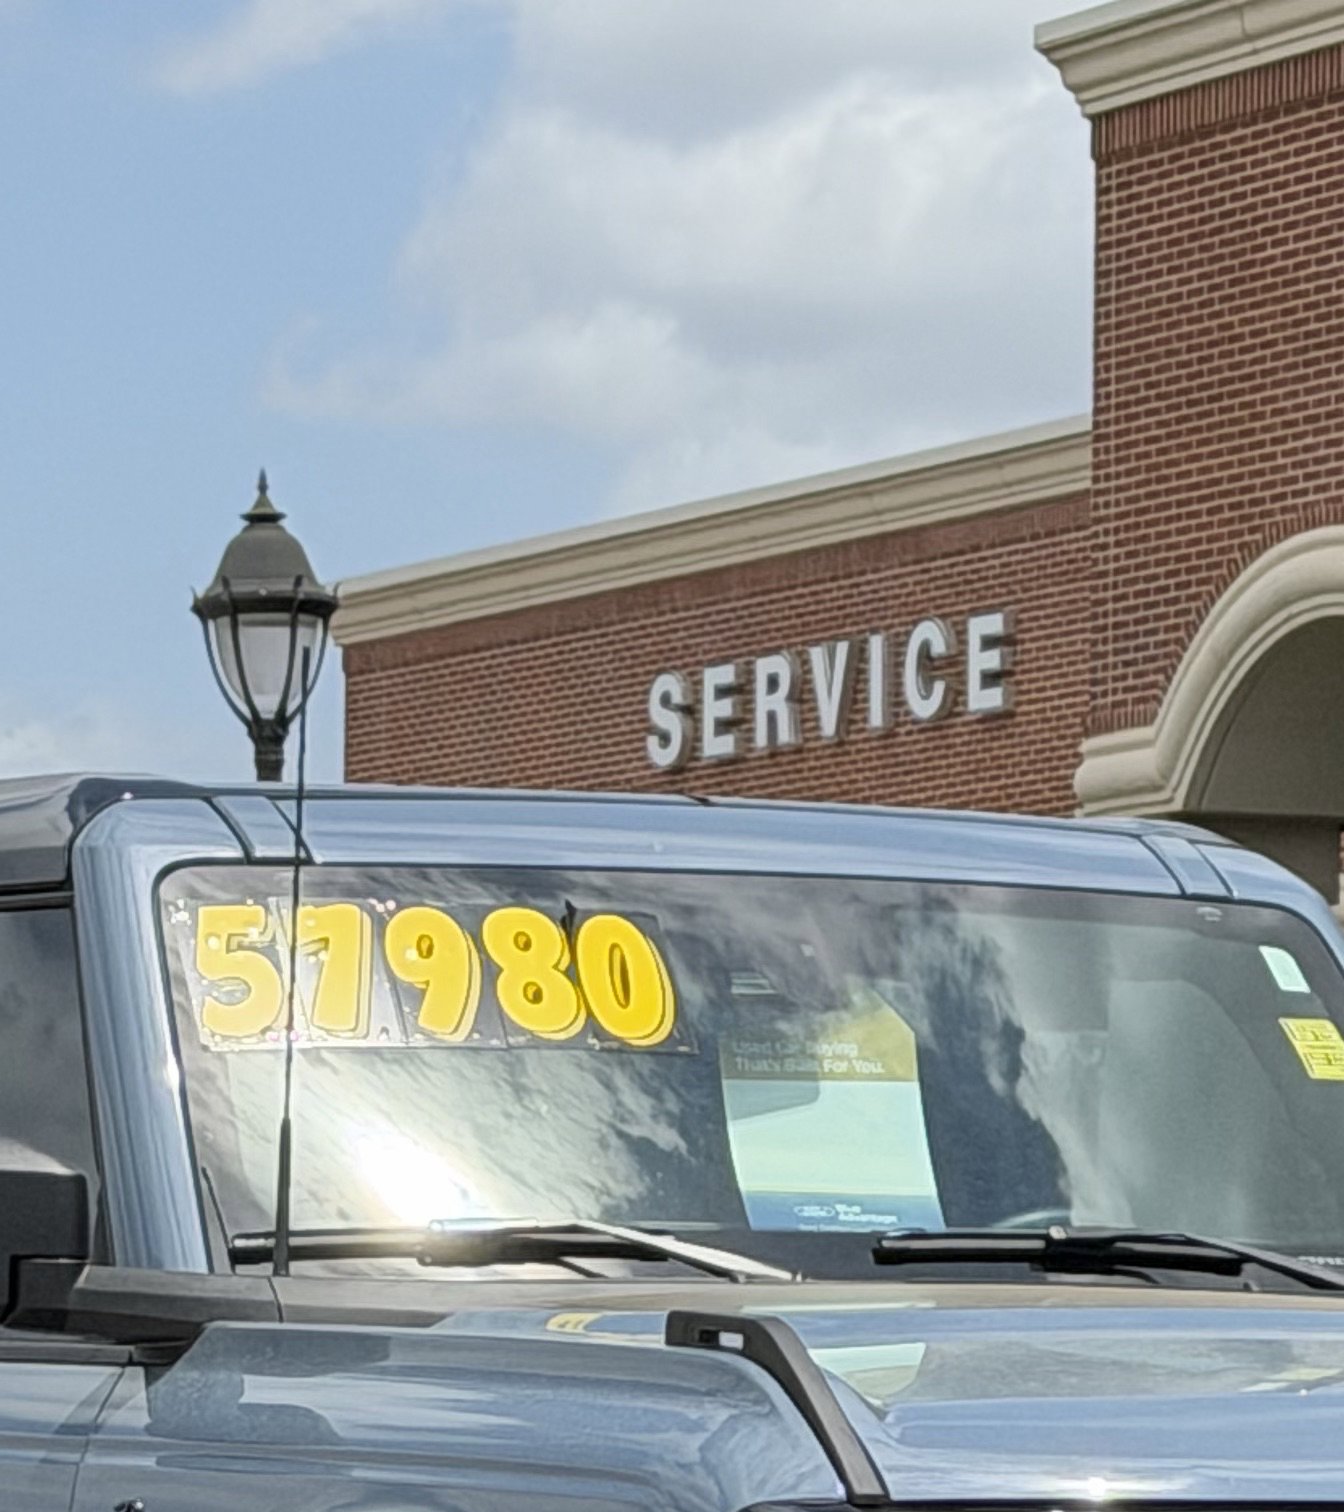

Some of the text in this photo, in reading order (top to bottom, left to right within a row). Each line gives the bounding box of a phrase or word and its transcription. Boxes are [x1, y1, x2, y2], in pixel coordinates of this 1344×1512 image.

[646, 612, 1006, 769] SERVICE
[196, 903, 675, 1047] 57980
[823, 1058, 849, 1073] For
